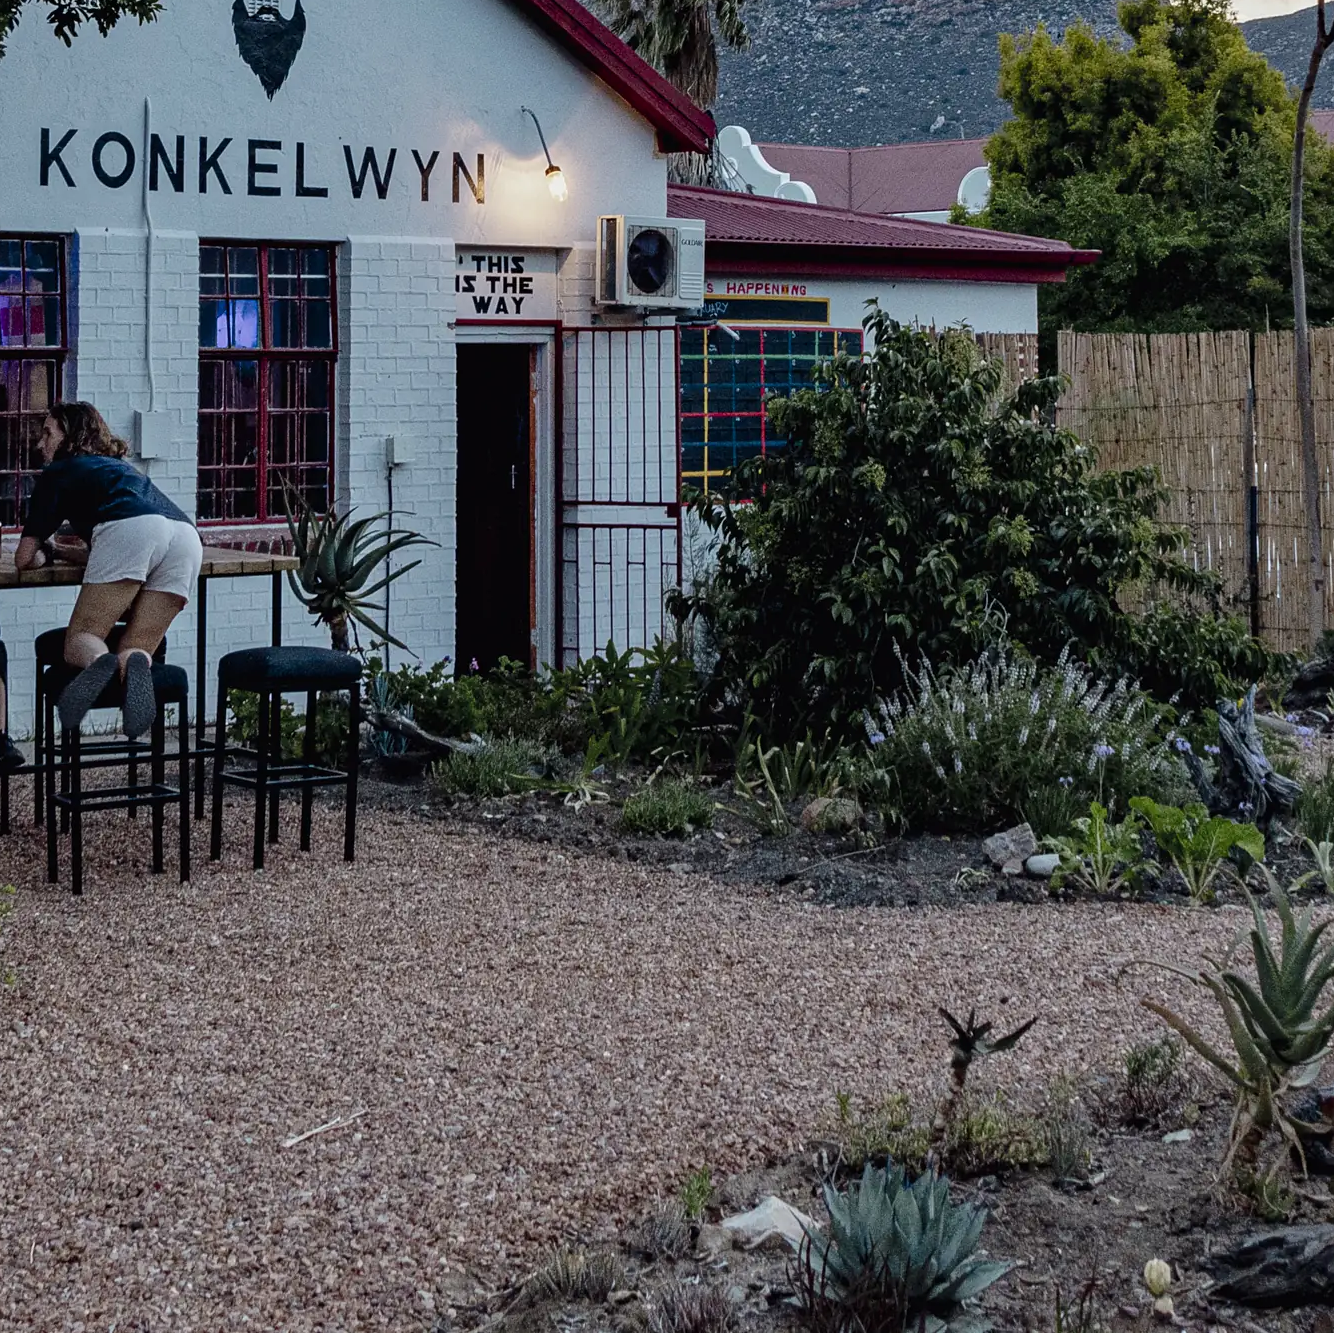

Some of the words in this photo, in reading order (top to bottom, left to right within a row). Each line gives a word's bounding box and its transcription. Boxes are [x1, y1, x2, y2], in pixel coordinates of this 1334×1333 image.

[39, 127, 485, 204] KONKELWYN
[471, 255, 525, 274] THIS
[455, 274, 477, 293] IS
[486, 275, 534, 294] THE
[471, 295, 526, 314] WAY
